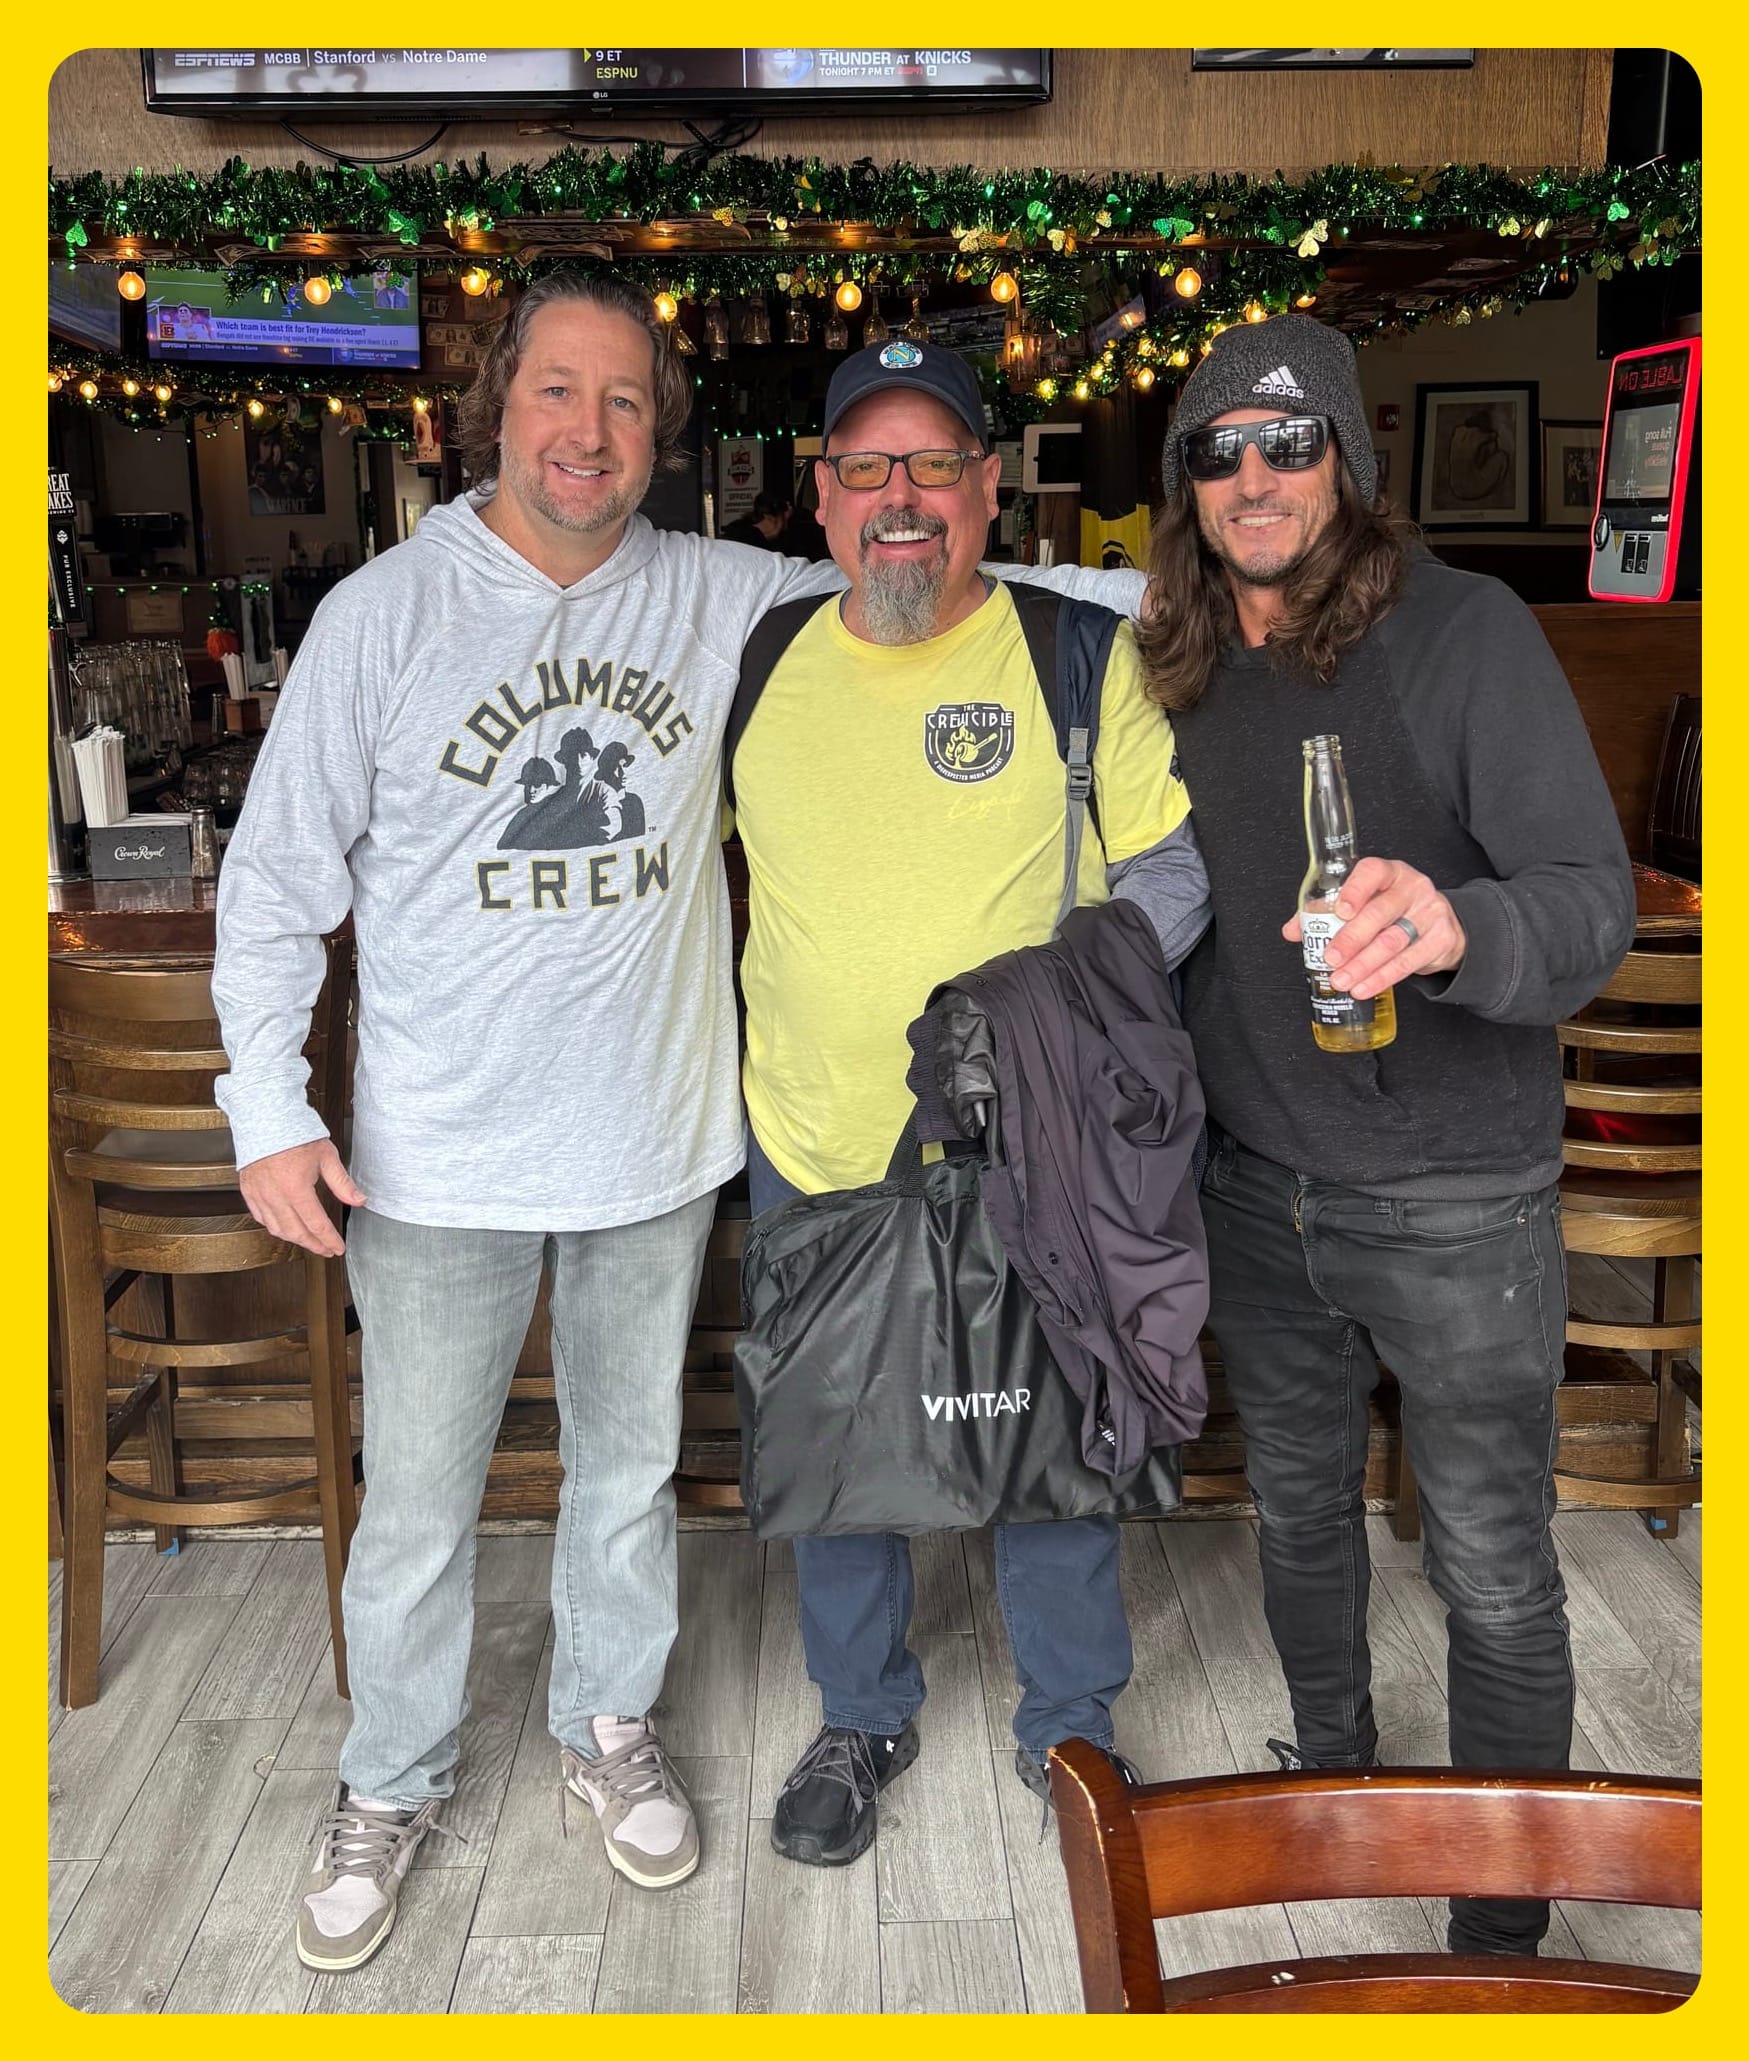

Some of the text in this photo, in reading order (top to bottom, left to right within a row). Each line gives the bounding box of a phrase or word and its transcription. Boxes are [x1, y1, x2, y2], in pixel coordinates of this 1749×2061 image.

[264, 53, 301, 65] MCBB
[314, 50, 376, 64] Stanford
[381, 53, 396, 63] vs
[403, 50, 443, 63] Notre
[446, 50, 487, 63] Dame
[596, 50, 622, 62] 9 ET
[819, 51, 891, 65] THUNDER
[915, 50, 971, 65] KNICKS
[596, 67, 638, 78] ESPNU
[819, 67, 859, 76] TONIGHT
[868, 67, 882, 76] PM
[884, 67, 895, 76] ET
[216, 321, 367, 337] Which team is best fit for Trey Hendrickson?
[1252, 384, 1305, 399] adidas
[438, 657, 695, 788] COLUMBUS
[114, 845, 166, 860] Crown Royal
[477, 841, 669, 910] CREW
[921, 1388, 1031, 1422] VIVITAR
